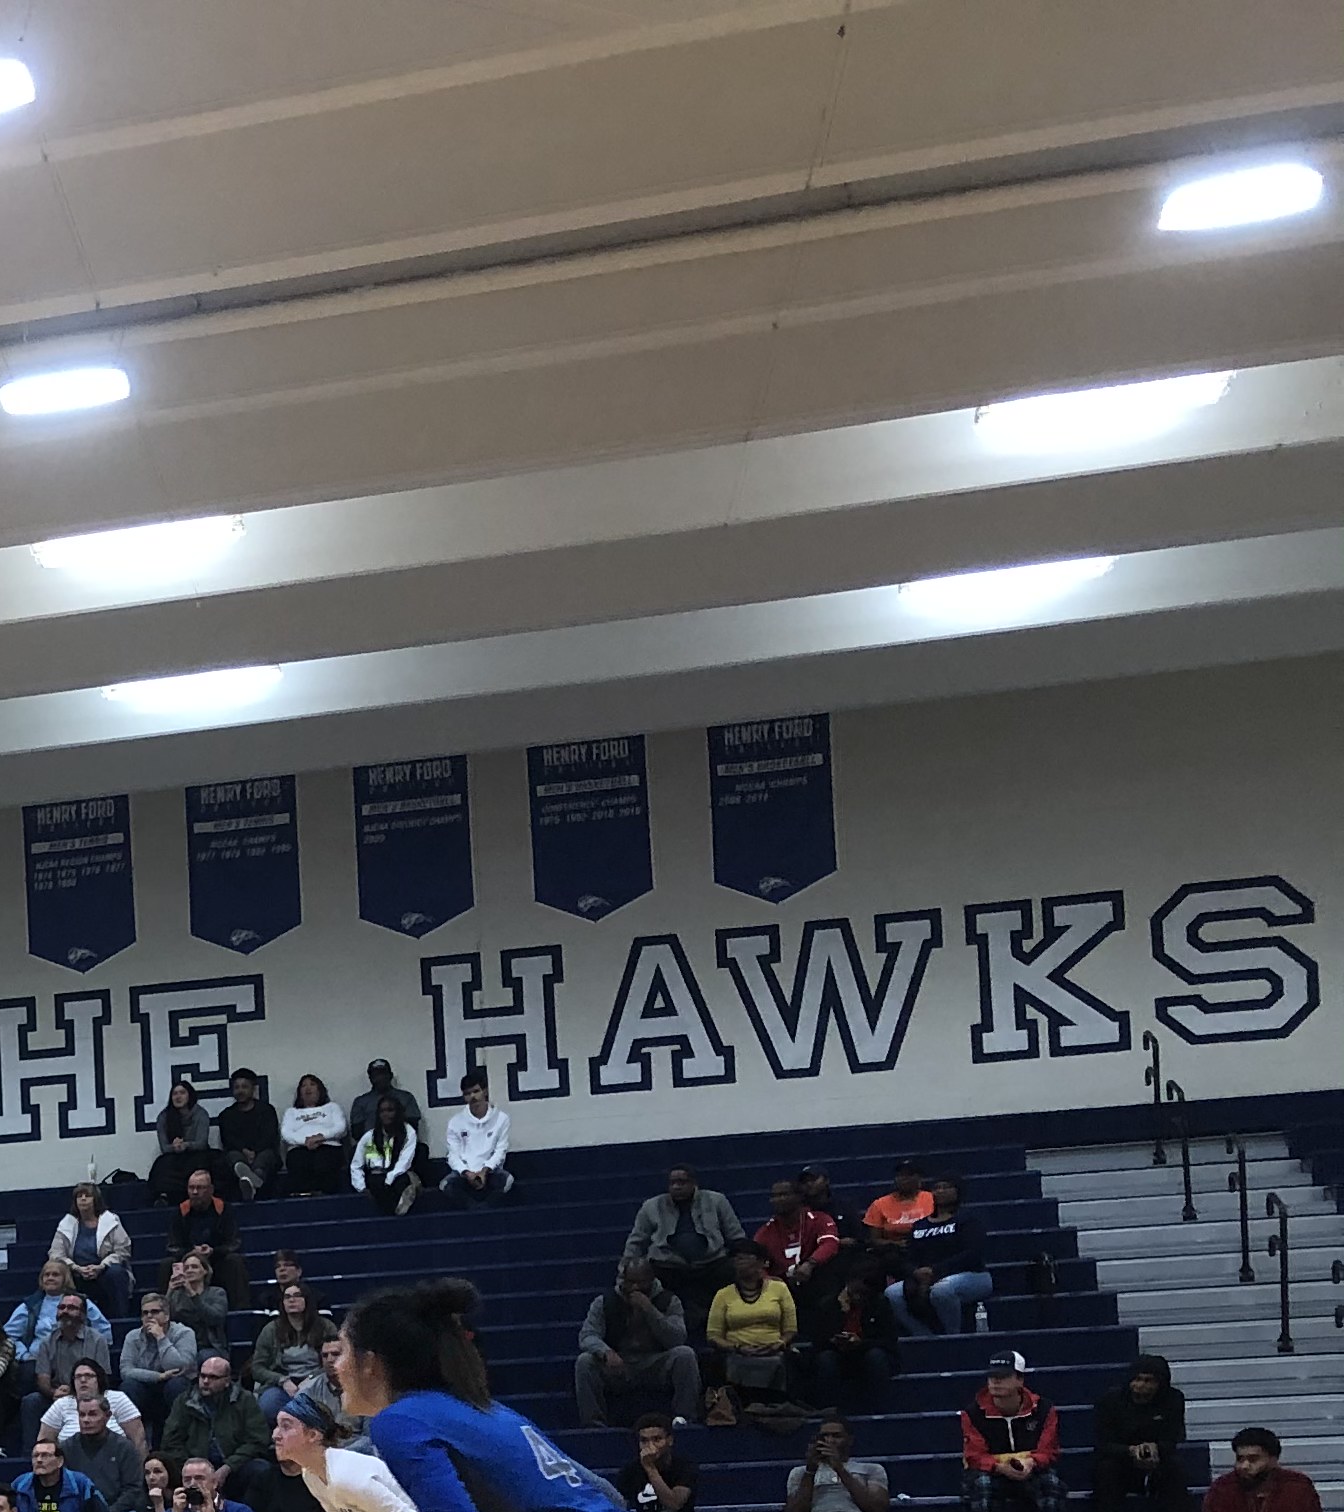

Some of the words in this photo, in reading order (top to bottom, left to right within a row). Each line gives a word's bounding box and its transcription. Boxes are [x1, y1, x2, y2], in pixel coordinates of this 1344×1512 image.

[724, 724, 769, 746] HENRY
[774, 718, 813, 740] FORD
[543, 744, 587, 766] HENRY
[592, 739, 629, 761] FORD
[368, 764, 411, 785] HENRY
[415, 759, 452, 780] FORD
[200, 784, 241, 804] HENRY
[246, 779, 280, 800] FORD
[37, 804, 77, 824] HENRY
[81, 799, 115, 820] FORD
[420, 874, 1322, 1108] HAWKS
[520, 1425, 582, 1488] 4
